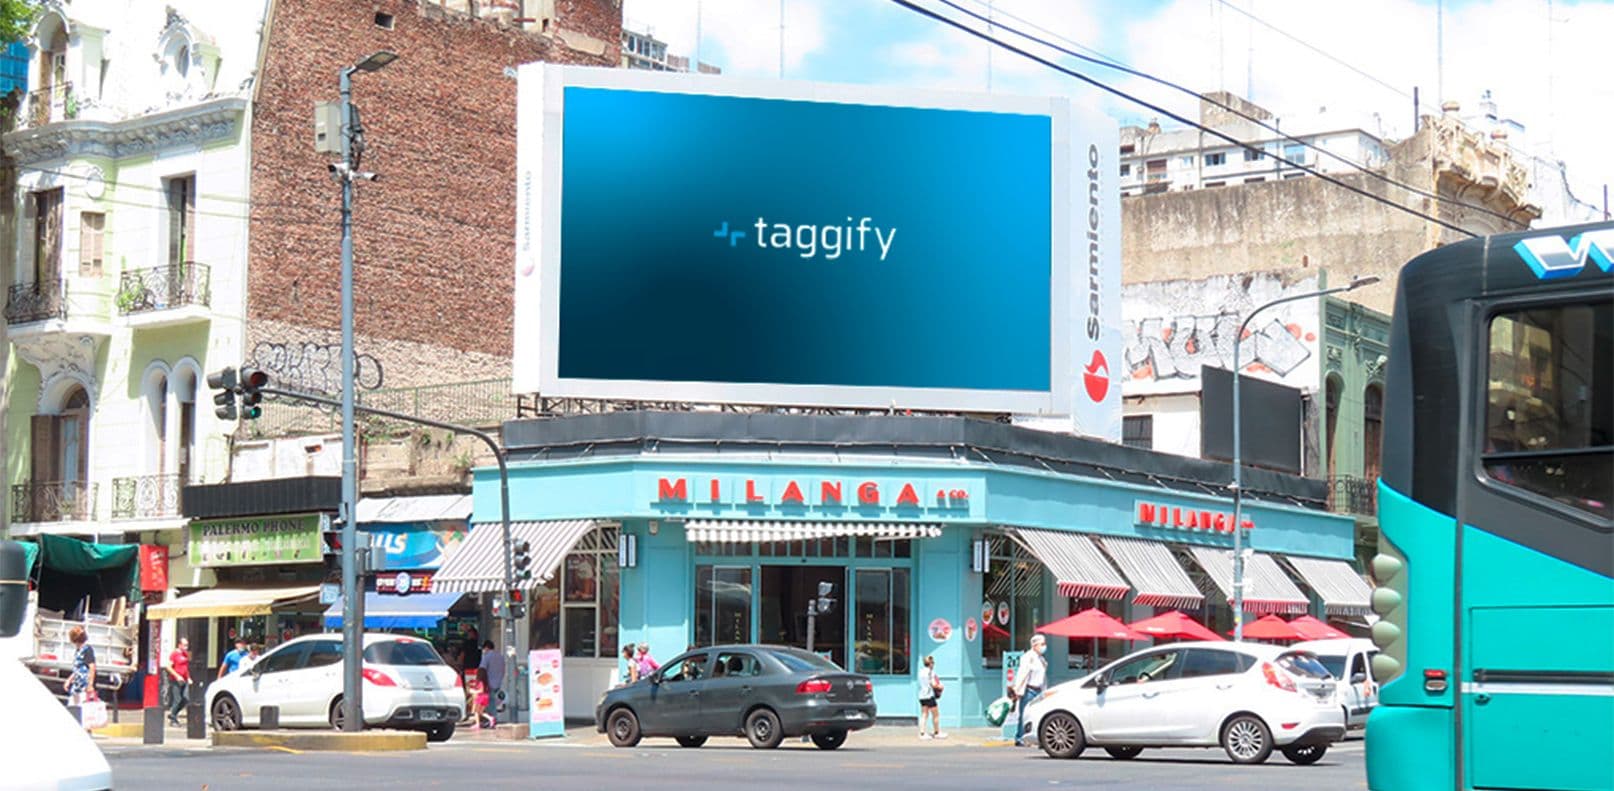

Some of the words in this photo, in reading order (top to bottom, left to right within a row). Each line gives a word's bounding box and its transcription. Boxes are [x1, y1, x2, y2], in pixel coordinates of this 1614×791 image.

[754, 216, 897, 261] taggify
[1086, 144, 1100, 341] Sarmiento
[658, 478, 920, 504] MILANGA
[202, 523, 260, 537] PALERMO
[263, 519, 305, 533] PHONE
